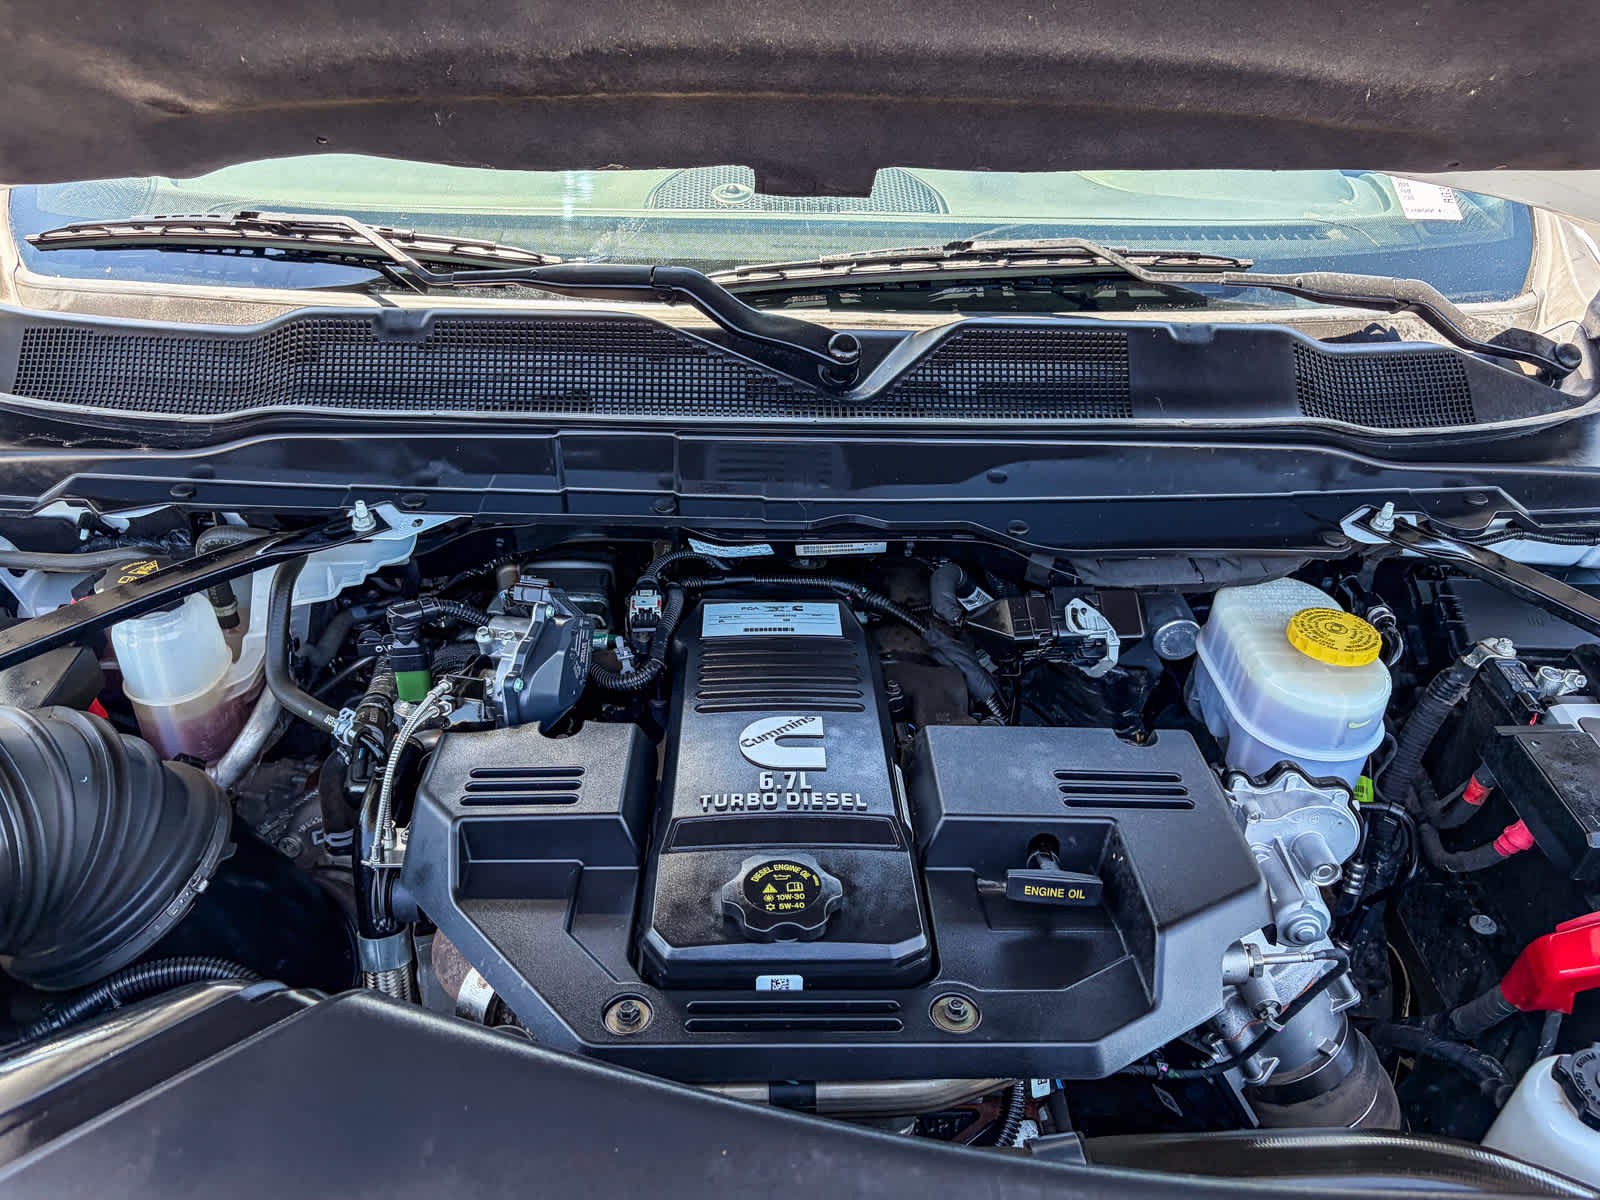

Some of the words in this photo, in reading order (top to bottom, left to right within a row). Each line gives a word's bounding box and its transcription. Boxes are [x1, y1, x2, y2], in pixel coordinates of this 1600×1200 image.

[741, 715, 816, 748] Cummins
[759, 771, 812, 792] 6.7L
[700, 792, 778, 811] TURBO
[786, 792, 868, 811] DIESEL
[750, 866, 774, 882] DIESEL
[773, 864, 802, 873] ENGINE
[799, 870, 812, 880] OIL
[776, 893, 806, 901] 10W-30
[1024, 885, 1065, 898] ENGINE
[1067, 889, 1086, 900] OIL
[778, 902, 806, 910] 5W-40
